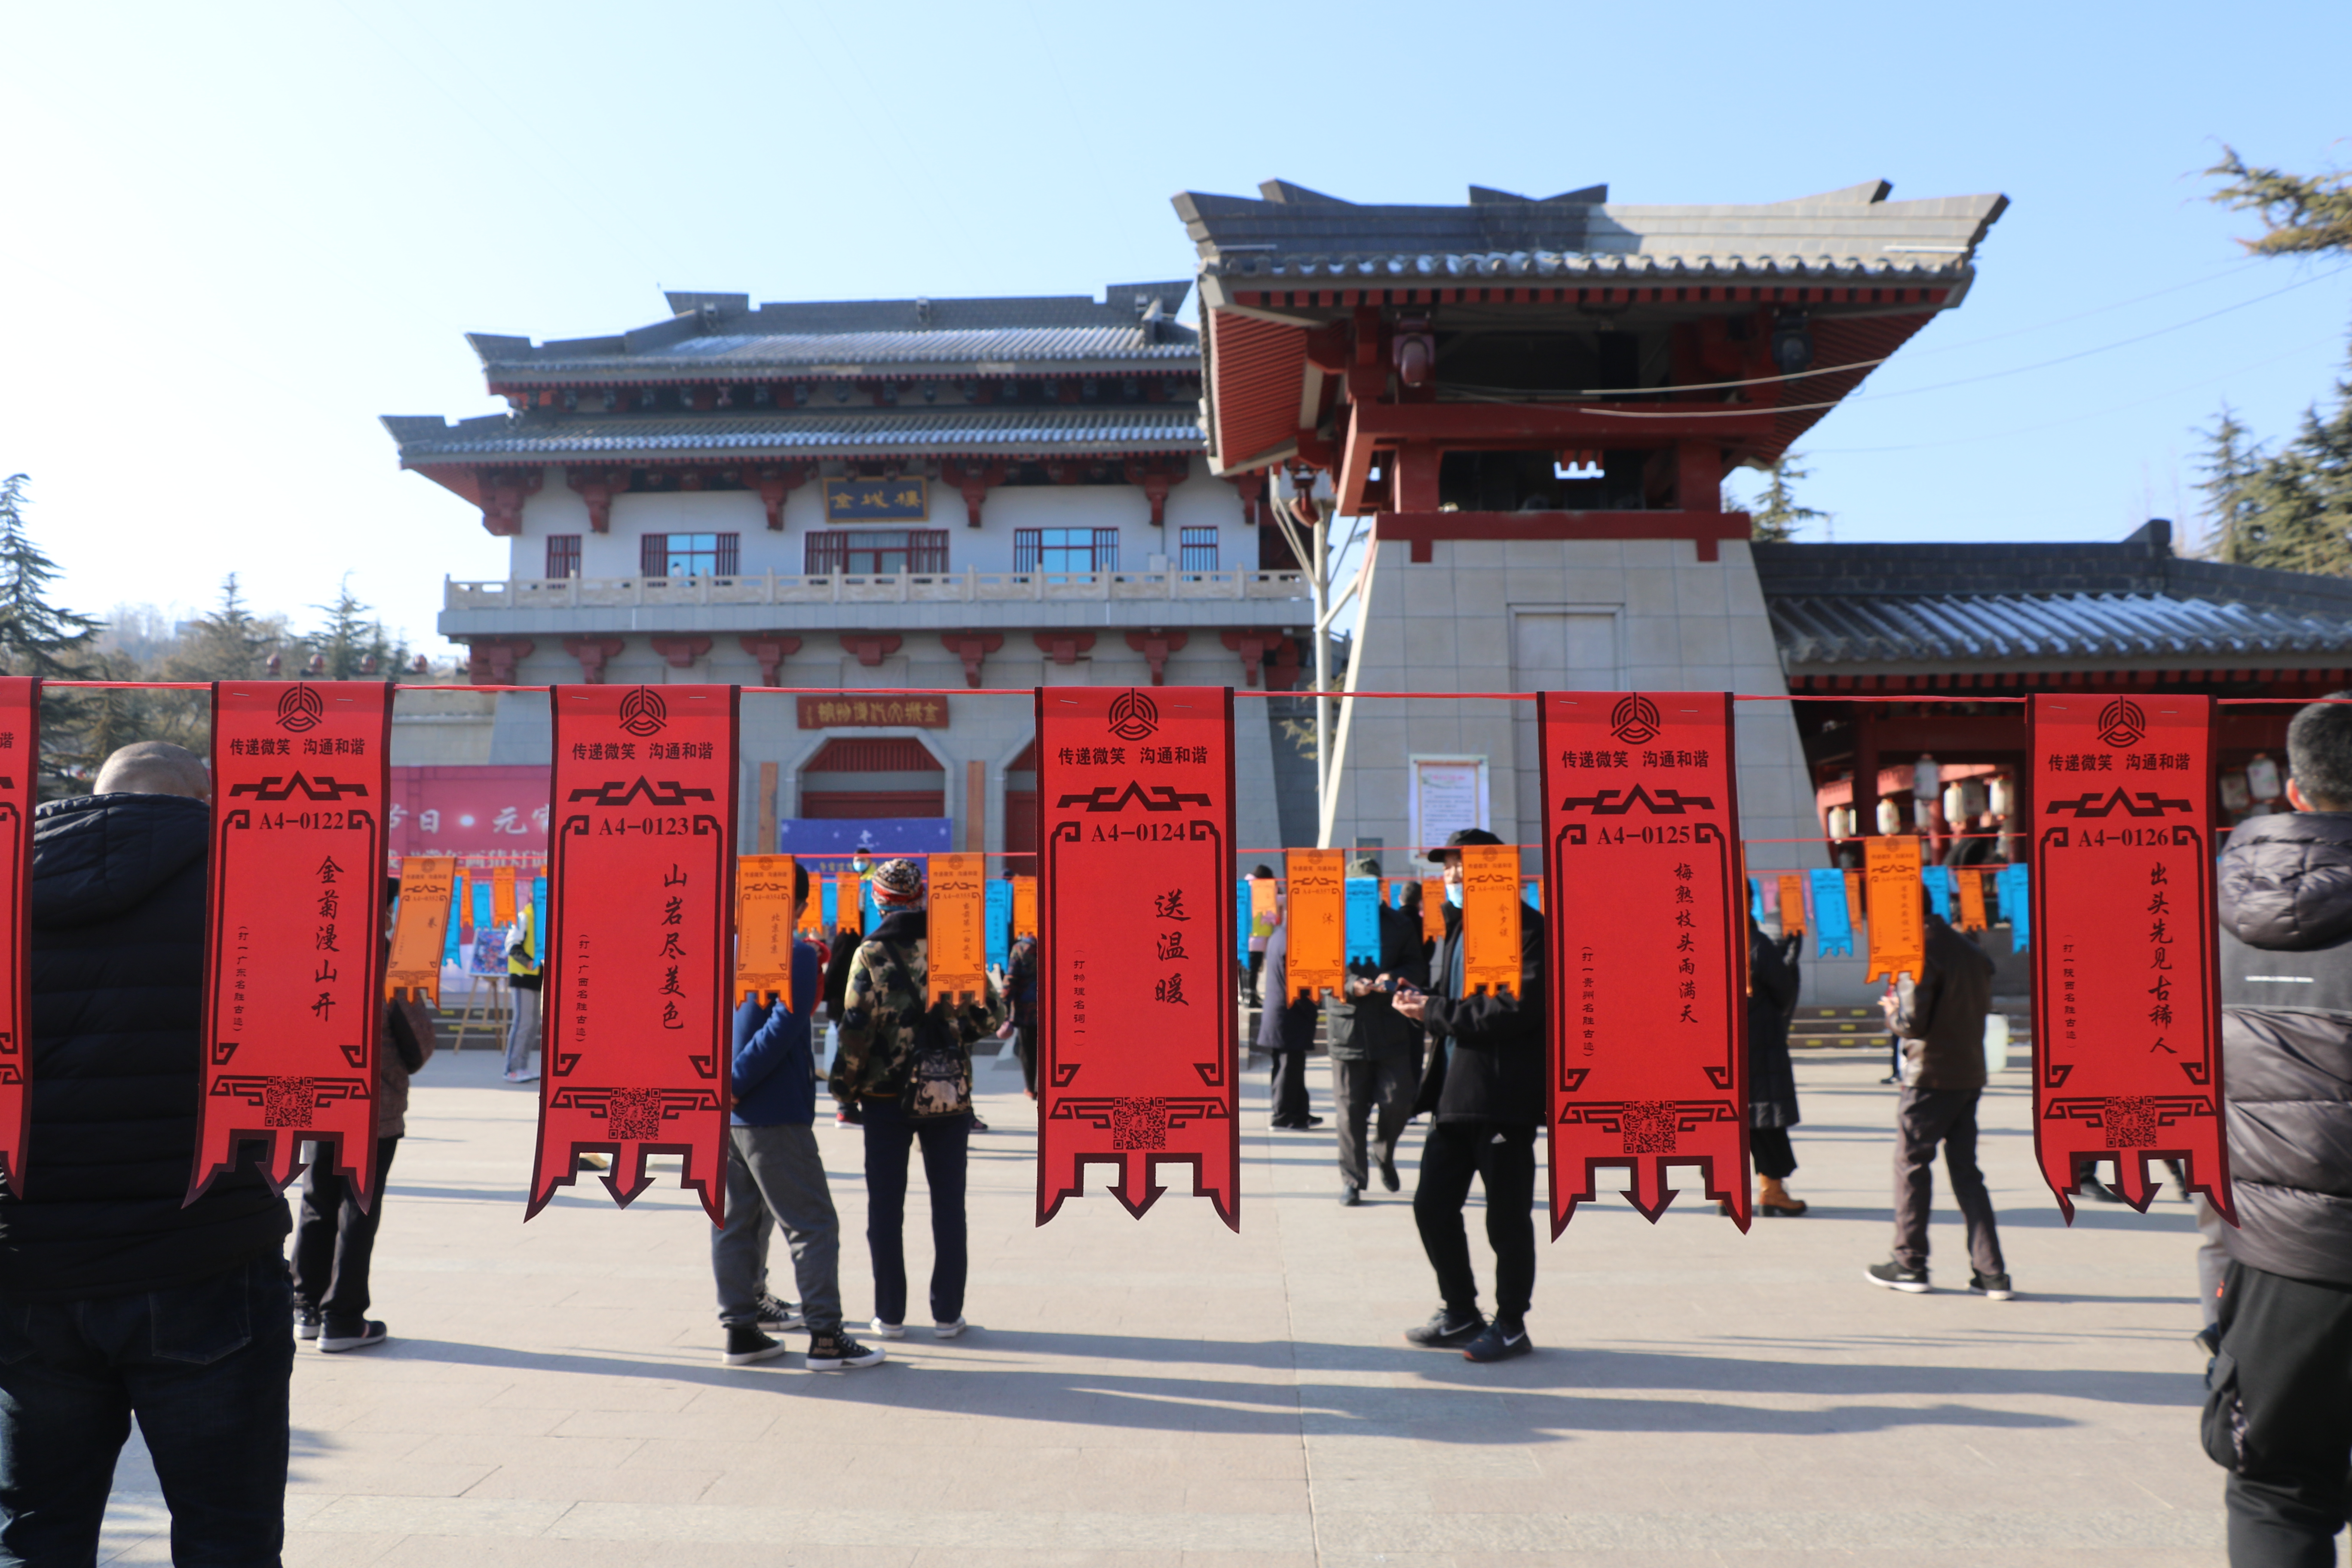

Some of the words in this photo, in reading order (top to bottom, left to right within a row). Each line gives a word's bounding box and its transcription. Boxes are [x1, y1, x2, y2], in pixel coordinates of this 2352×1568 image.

[231, 739, 290, 755] 传递微笑
[304, 739, 364, 754] 沟通和谐
[573, 744, 635, 760] 传递微笑
[650, 743, 713, 759] 沟通和谐
[1059, 748, 1125, 765] 传递微笑
[1141, 747, 1207, 763] 沟通和谐
[1562, 751, 1628, 767] 传递微笑
[1644, 751, 1708, 767] 沟通和谐
[2049, 755, 2112, 771] 传递微笑
[2127, 754, 2190, 770] 沟通和谐
[260, 813, 343, 829] A4-0122
[600, 818, 688, 835] A4-0123
[1092, 824, 1185, 841] A4-0124
[1598, 826, 1689, 844] A4-0125
[2079, 829, 2168, 846] A4-0126
[312, 856, 343, 1021] 金菊漫山开
[659, 864, 687, 1029] 山岩尽美色
[1155, 889, 1191, 1005] 送温暖
[1674, 863, 1697, 1023] 梅熟枝头雨满天
[2147, 862, 2177, 1054] 出头先见古稀人
